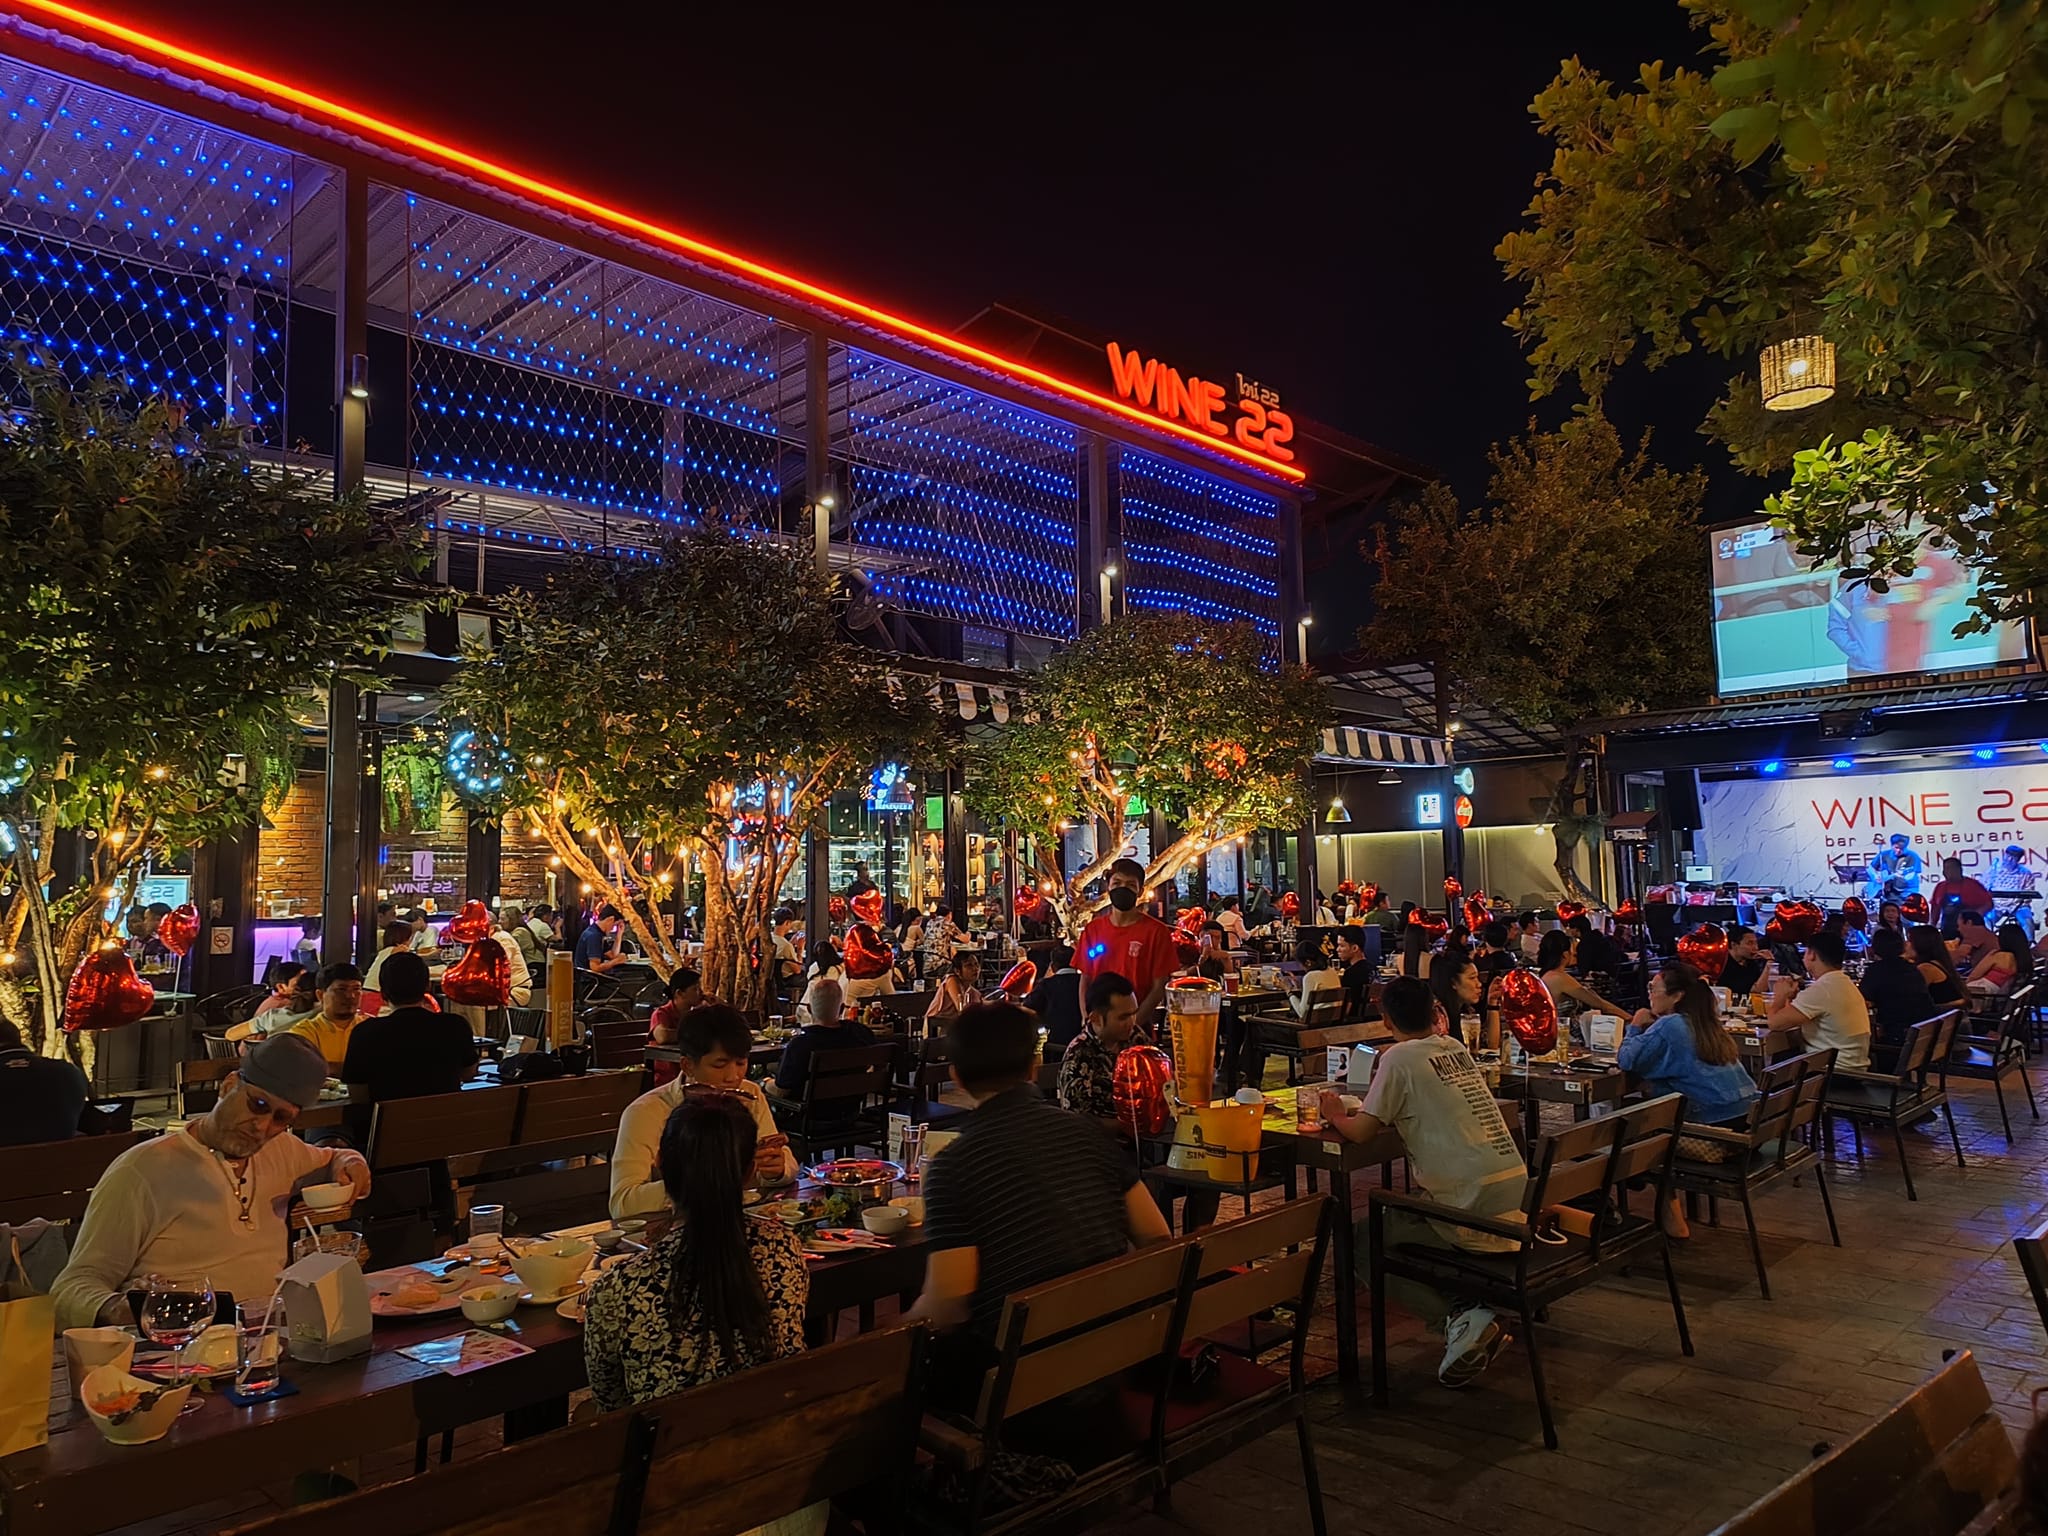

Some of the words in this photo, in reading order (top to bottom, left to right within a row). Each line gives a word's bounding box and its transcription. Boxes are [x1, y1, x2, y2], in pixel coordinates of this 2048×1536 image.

[1107, 341, 1228, 436] WINE
[1236, 399, 1294, 461] 22
[1811, 792, 1953, 830] WINE
[1825, 834, 1856, 847] bar
[1914, 829, 2024, 844] estaurant
[392, 881, 430, 894] WINE
[1172, 1020, 1188, 1090] SINGHA
